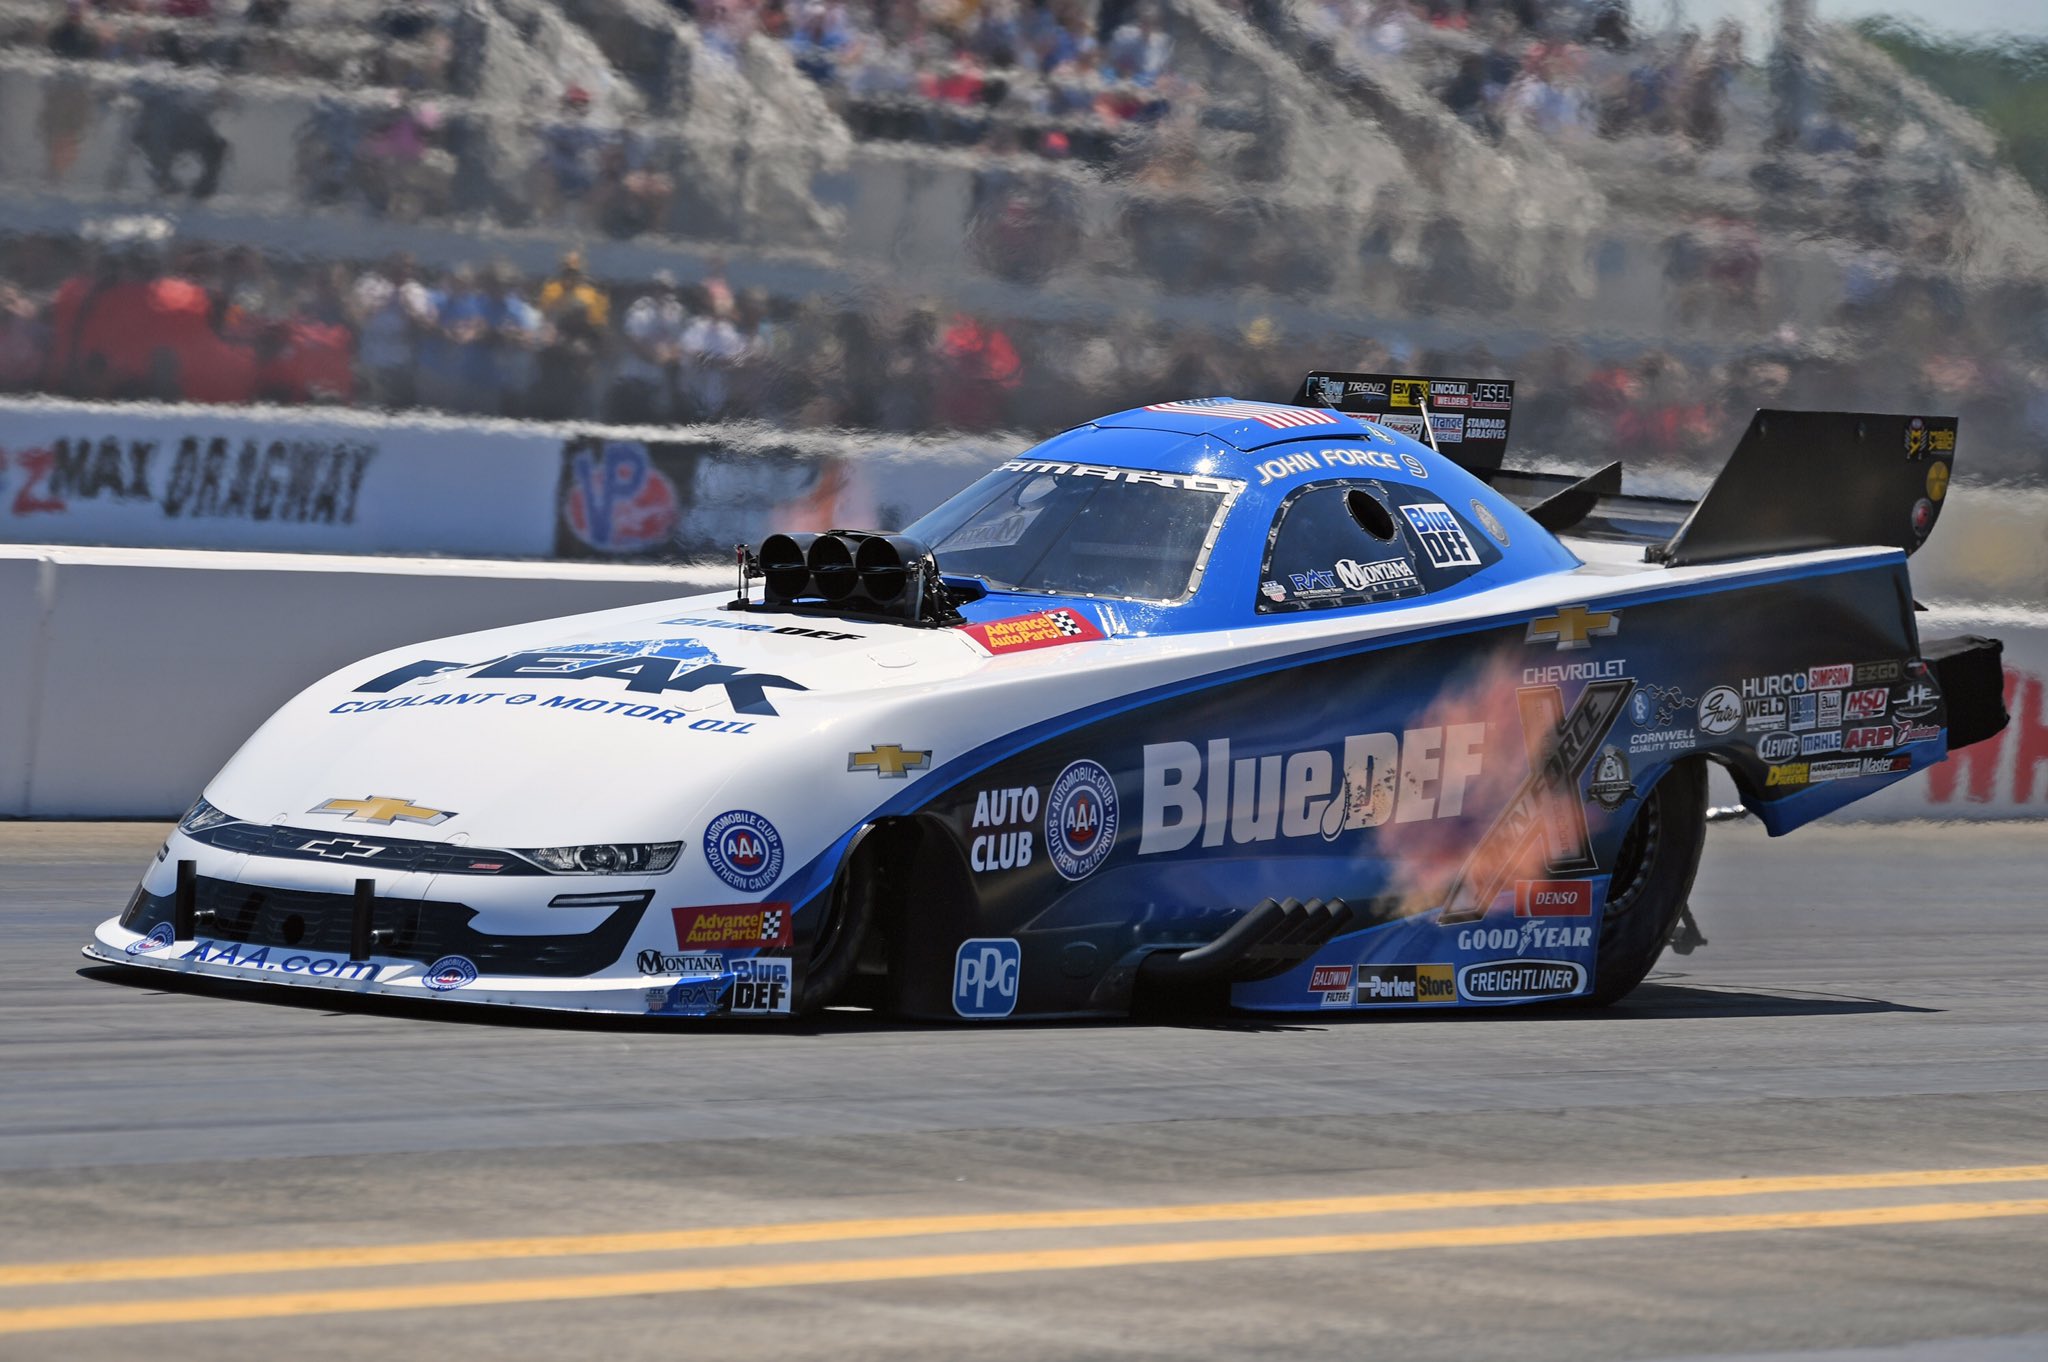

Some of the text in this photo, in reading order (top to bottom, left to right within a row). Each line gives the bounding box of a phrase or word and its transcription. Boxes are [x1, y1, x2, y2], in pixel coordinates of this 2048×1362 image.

[1348, 382, 1386, 392] TREND
[1430, 384, 1466, 394] LINCOLN
[1472, 383, 1512, 402] JESEL
[1437, 395, 1469, 405] WELDERS
[1465, 429, 1506, 439] ABRASIVES
[1466, 418, 1505, 428] STANDARD
[1254, 452, 1320, 486] JOHN
[1320, 448, 1402, 471] FORCE
[1405, 507, 1461, 532] Blue
[1423, 531, 1478, 564] DEF
[1288, 569, 1336, 590] RMT
[983, 617, 1049, 638] Advance
[988, 629, 1058, 648] Auto Parts
[1523, 659, 1626, 684] CHEVROLET
[1810, 667, 1851, 688] SIMPSON
[351, 652, 809, 716] PEAK
[1742, 672, 1808, 698] HURCO
[1744, 697, 1786, 718] WELD
[1848, 689, 1887, 712] MSD
[329, 692, 504, 714] COOLANT
[538, 695, 687, 724] MOTOR
[688, 719, 758, 735] OIL
[1629, 740, 1697, 754] QUALITY TOOLS
[1630, 728, 1696, 745] CORNWELL
[1757, 735, 1799, 760] CLEVITE
[1803, 732, 1841, 752] MAHLE
[1844, 726, 1894, 749] ARP
[1052, 767, 1114, 813] AUTOMOBILE CLUB
[972, 786, 1039, 828] AUTO
[1066, 803, 1098, 832] AAA
[707, 812, 778, 843] AUTOMOBILE CLUB
[727, 837, 763, 859] AAA
[971, 831, 1033, 873] CLUB
[1049, 813, 1116, 875] SOUTHERN CALIFORNIA
[707, 847, 782, 890] SOUTHERN CALIFORNIA
[1535, 891, 1578, 905] DENSO
[692, 913, 758, 930] Advance
[686, 927, 757, 943] Auto Parts
[179, 940, 381, 982] AAA.com
[637, 949, 722, 975] MONTANA
[731, 960, 788, 983] Blue
[958, 947, 1017, 1008] PPG
[1312, 971, 1349, 986] BALDWIN
[1470, 969, 1574, 992] FREIGHTLINER
[732, 982, 787, 1010] DEF
[1325, 992, 1351, 1003] FILTERS
